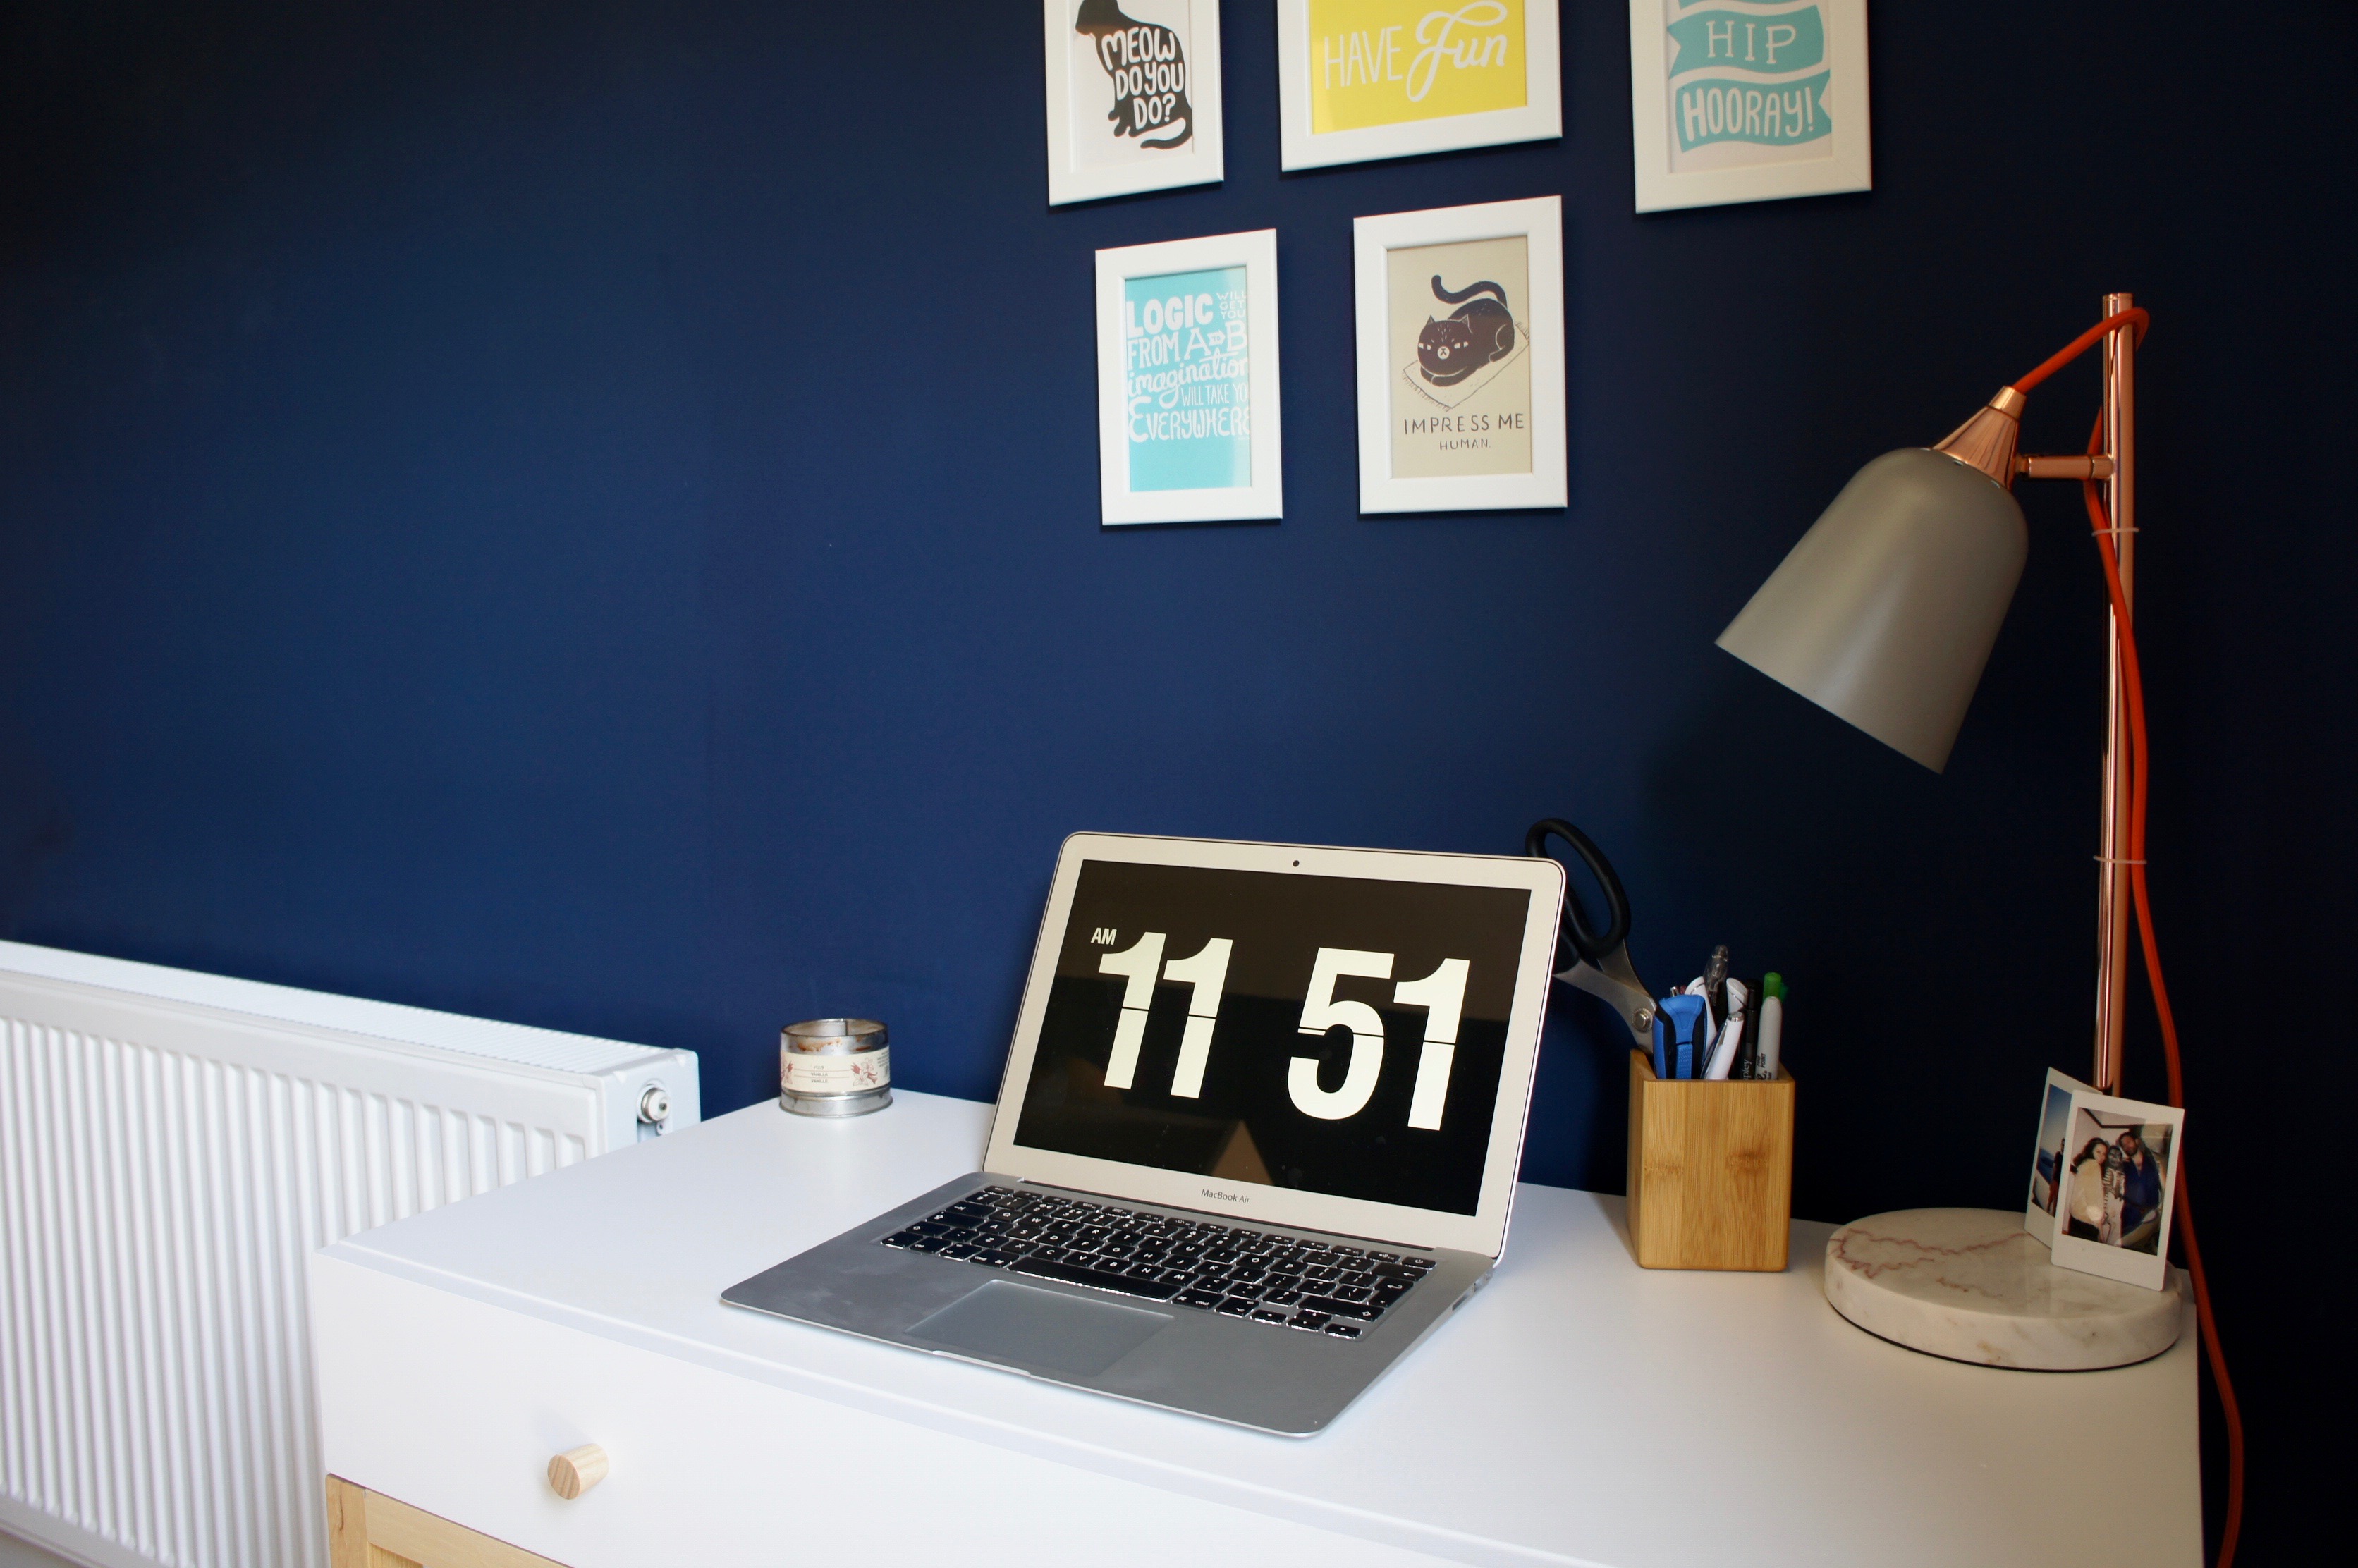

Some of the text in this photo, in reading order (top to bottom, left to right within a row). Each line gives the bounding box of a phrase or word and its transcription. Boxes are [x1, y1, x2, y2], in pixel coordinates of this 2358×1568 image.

[1101, 27, 1175, 71] MEOW
[1324, 0, 1508, 102] HAVE Fun
[1706, 20, 1797, 64] HIP
[1115, 61, 1184, 101] DO YOU
[1133, 93, 1176, 130] DO?
[1682, 86, 1815, 142] HOORAY!
[1216, 290, 1247, 300] WILL
[1220, 300, 1245, 310] GET
[1126, 293, 1214, 338] LOGIC
[1220, 309, 1246, 319] YOU
[1127, 331, 1180, 371] FROM
[1184, 327, 1211, 360] A
[1225, 320, 1247, 352] B
[1180, 386, 1204, 407] WILL
[1204, 384, 1230, 405] TAKE
[1404, 413, 1525, 435] IMPRESS ME
[1439, 438, 1491, 451] HUMAN.
[1091, 928, 1116, 945] AM
[1098, 932, 1470, 1131] 11 51
[1201, 1189, 1250, 1203] MacBook Air
